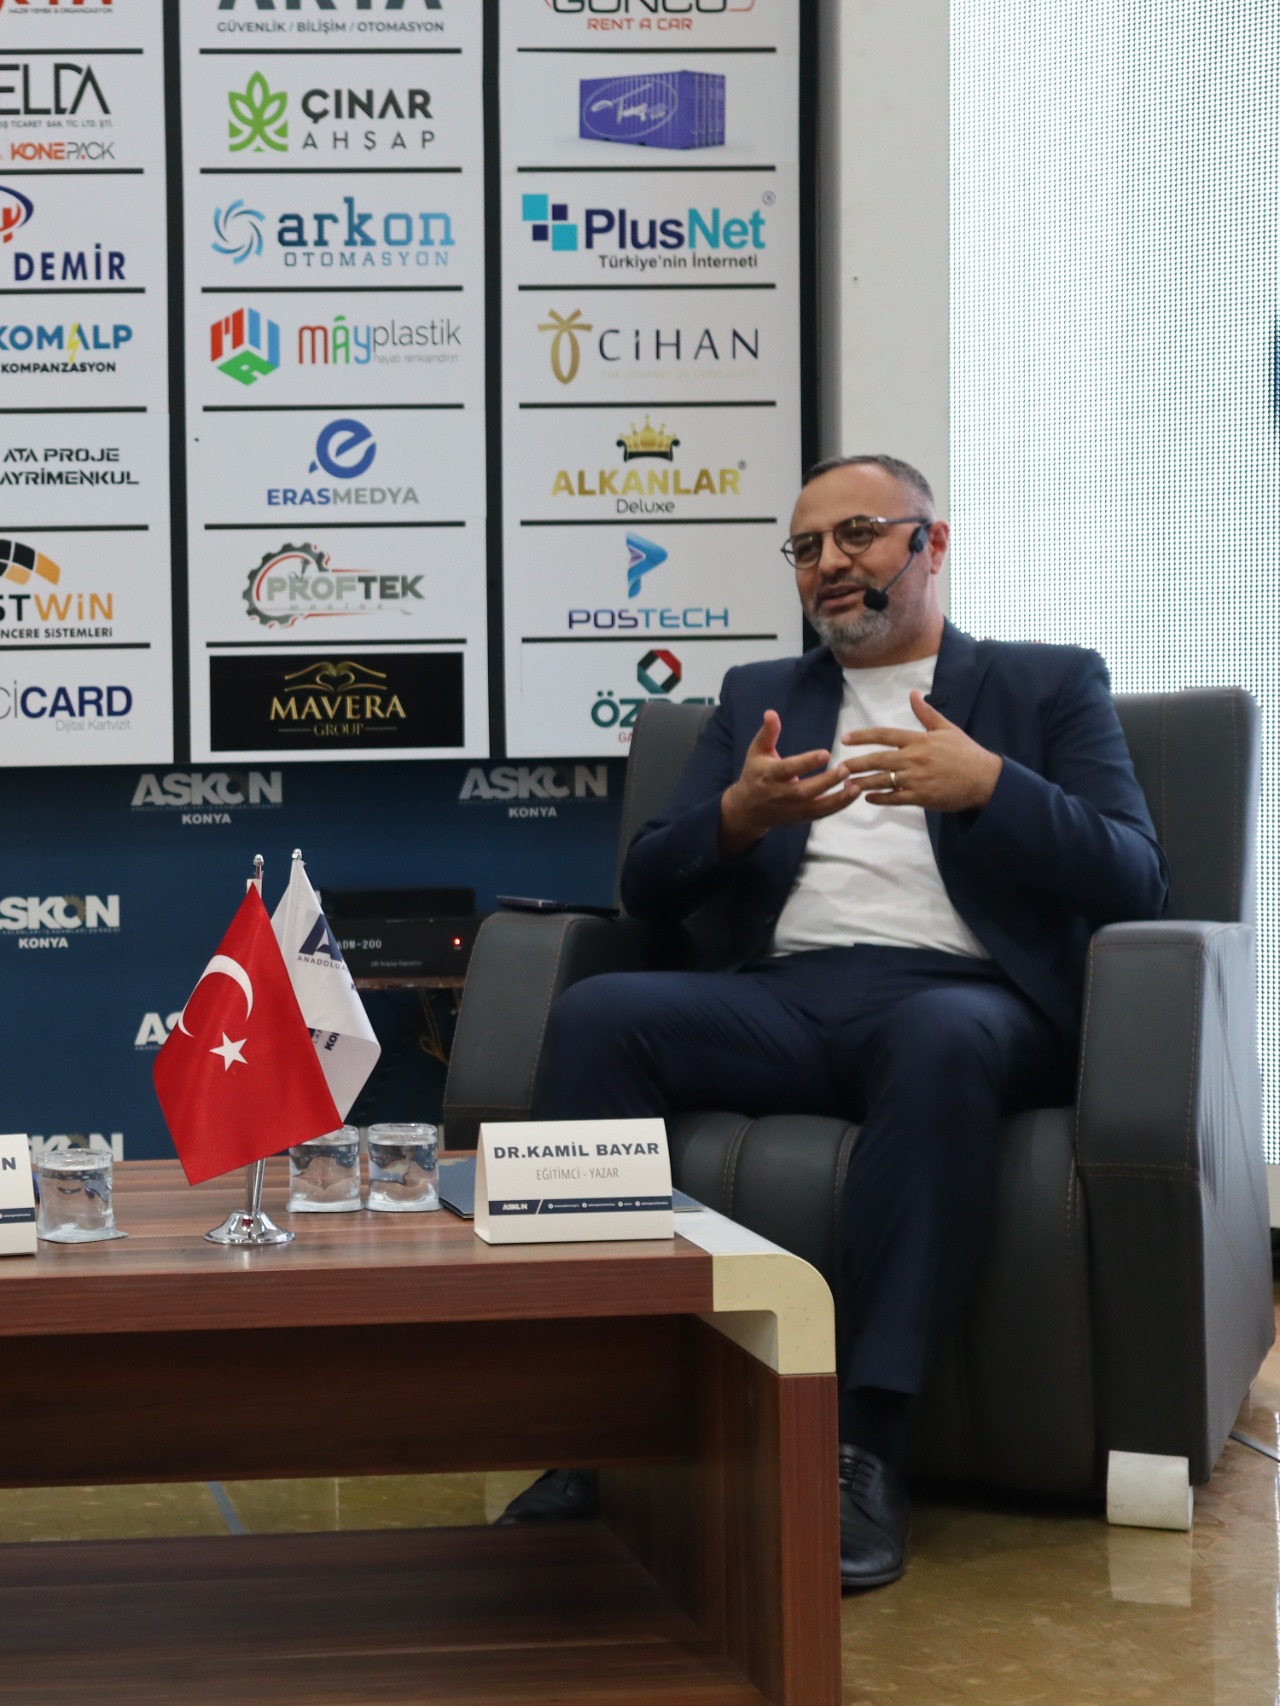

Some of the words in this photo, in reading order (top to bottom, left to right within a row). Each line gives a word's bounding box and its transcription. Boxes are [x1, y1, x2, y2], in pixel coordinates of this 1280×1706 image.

[217, 20, 286, 32] GÜVENLİK
[297, 19, 346, 35] BİLİŞİM
[357, 22, 444, 32] OTOMASYON
[587, 18, 635, 31] RENT
[657, 18, 693, 30] CAR
[301, 88, 433, 124] ÇINAR
[302, 130, 435, 150] AHŞAP
[277, 196, 456, 247] arkon
[585, 208, 766, 250] PlusNet
[14, 243, 126, 281] DEMİR
[284, 251, 449, 267] OTOMASYON
[692, 252, 758, 269] İnterneti
[1, 362, 116, 373] KOMPANZASYON
[3, 449, 38, 462] ATA
[44, 448, 120, 462] PROJE
[551, 468, 742, 497] ALKANLAR
[266, 487, 420, 506] ERASMEDYA
[616, 499, 675, 514] Deluxe
[266, 574, 425, 600] PROFTEK
[568, 608, 729, 629] POSTECH
[270, 694, 407, 721] MAVERA
[88, 719, 131, 731] Kartvizit
[314, 724, 364, 736] GROUP
[182, 813, 231, 825] KONYA
[509, 807, 557, 818] KONYA
[19, 937, 69, 949] KONYA
[298, 955, 340, 970] ANADOLU
[494, 1142, 589, 1159] DR.KAMİL
[597, 1142, 659, 1156] BAYAR
[537, 1166, 580, 1181] EĞİTİMCİ
[590, 1168, 619, 1180] YAZAR
